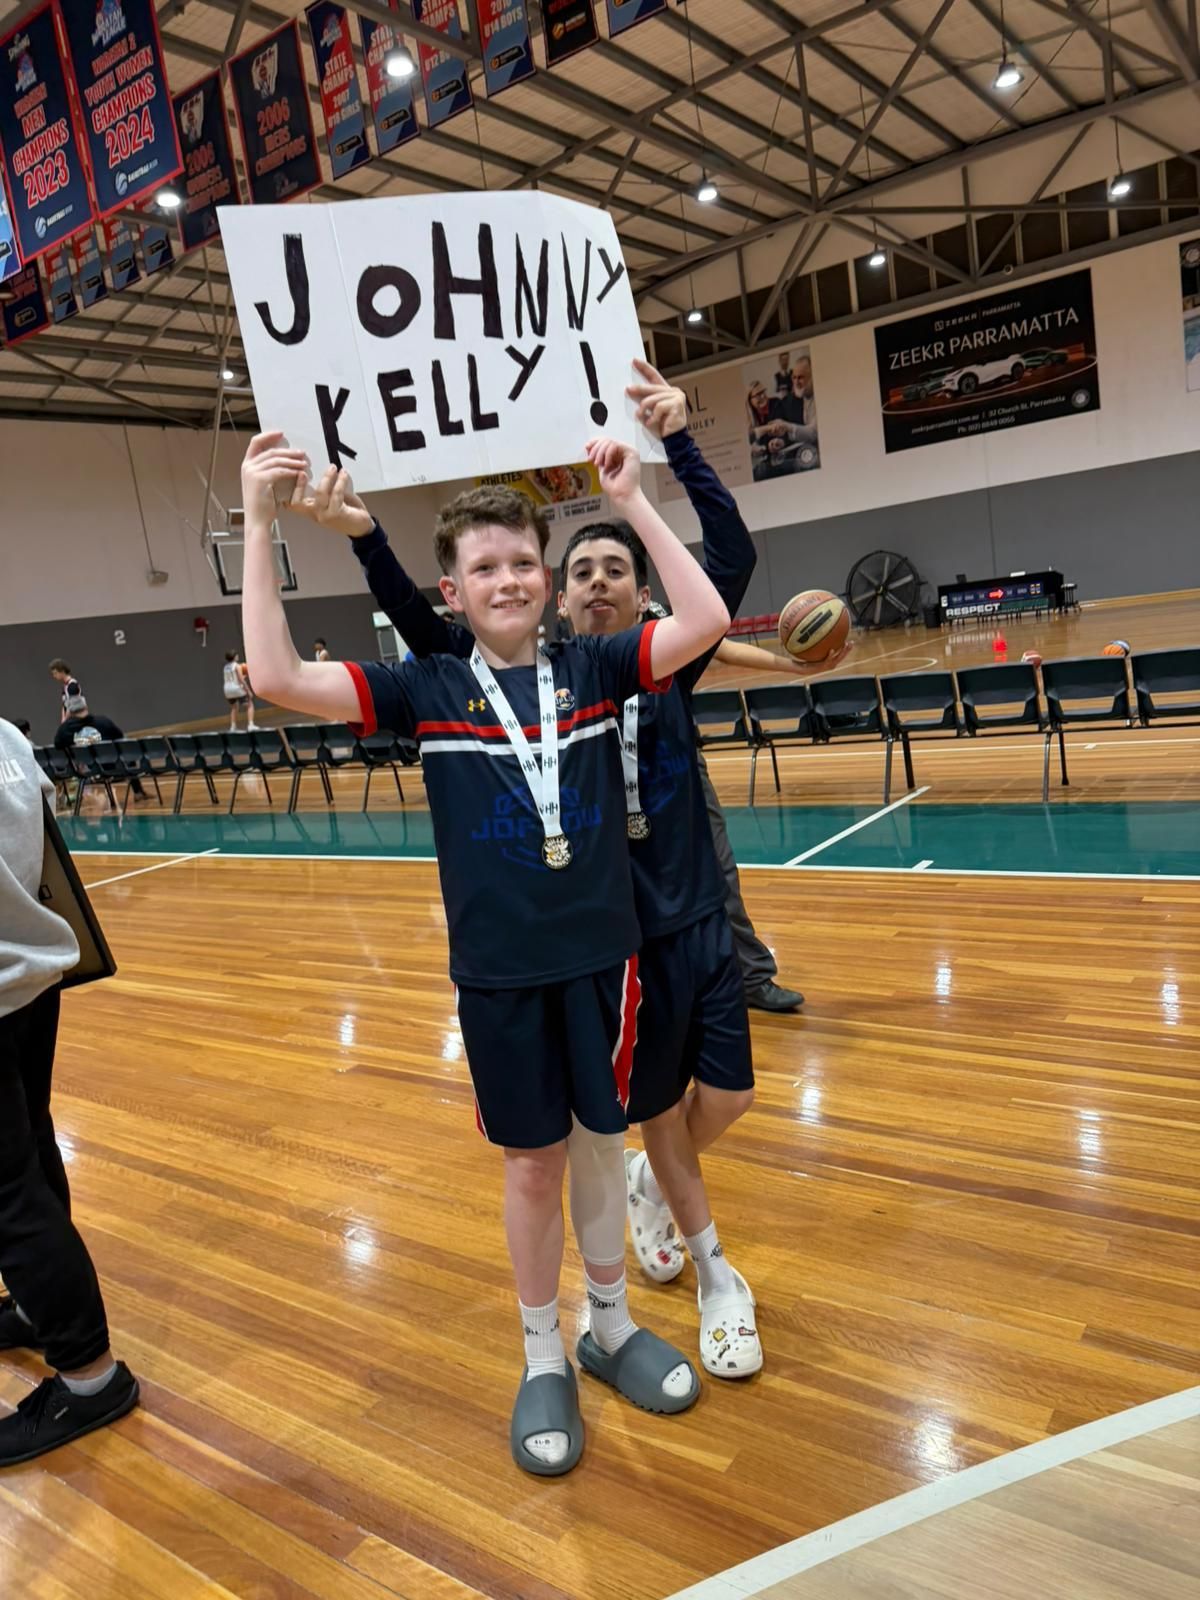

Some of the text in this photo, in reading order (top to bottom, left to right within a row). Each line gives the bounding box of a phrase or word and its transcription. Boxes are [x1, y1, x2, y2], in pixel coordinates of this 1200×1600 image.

[115, 44, 154, 87] WOMEN
[322, 63, 354, 95] CHAMPS
[325, 51, 347, 76] STATE
[21, 103, 46, 139] MEN
[92, 72, 156, 134] CHAMPIONS
[12, 118, 70, 177] CHAMPIONS
[105, 105, 155, 169] 2024
[23, 150, 70, 209] 2023
[253, 220, 625, 346] JOHNNY
[888, 306, 1080, 371] ZEEKR PARRAMATTA
[480, 471, 523, 487] ATHLETES
[945, 603, 1000, 617] RESPECT
[113, 629, 126, 645] 2
